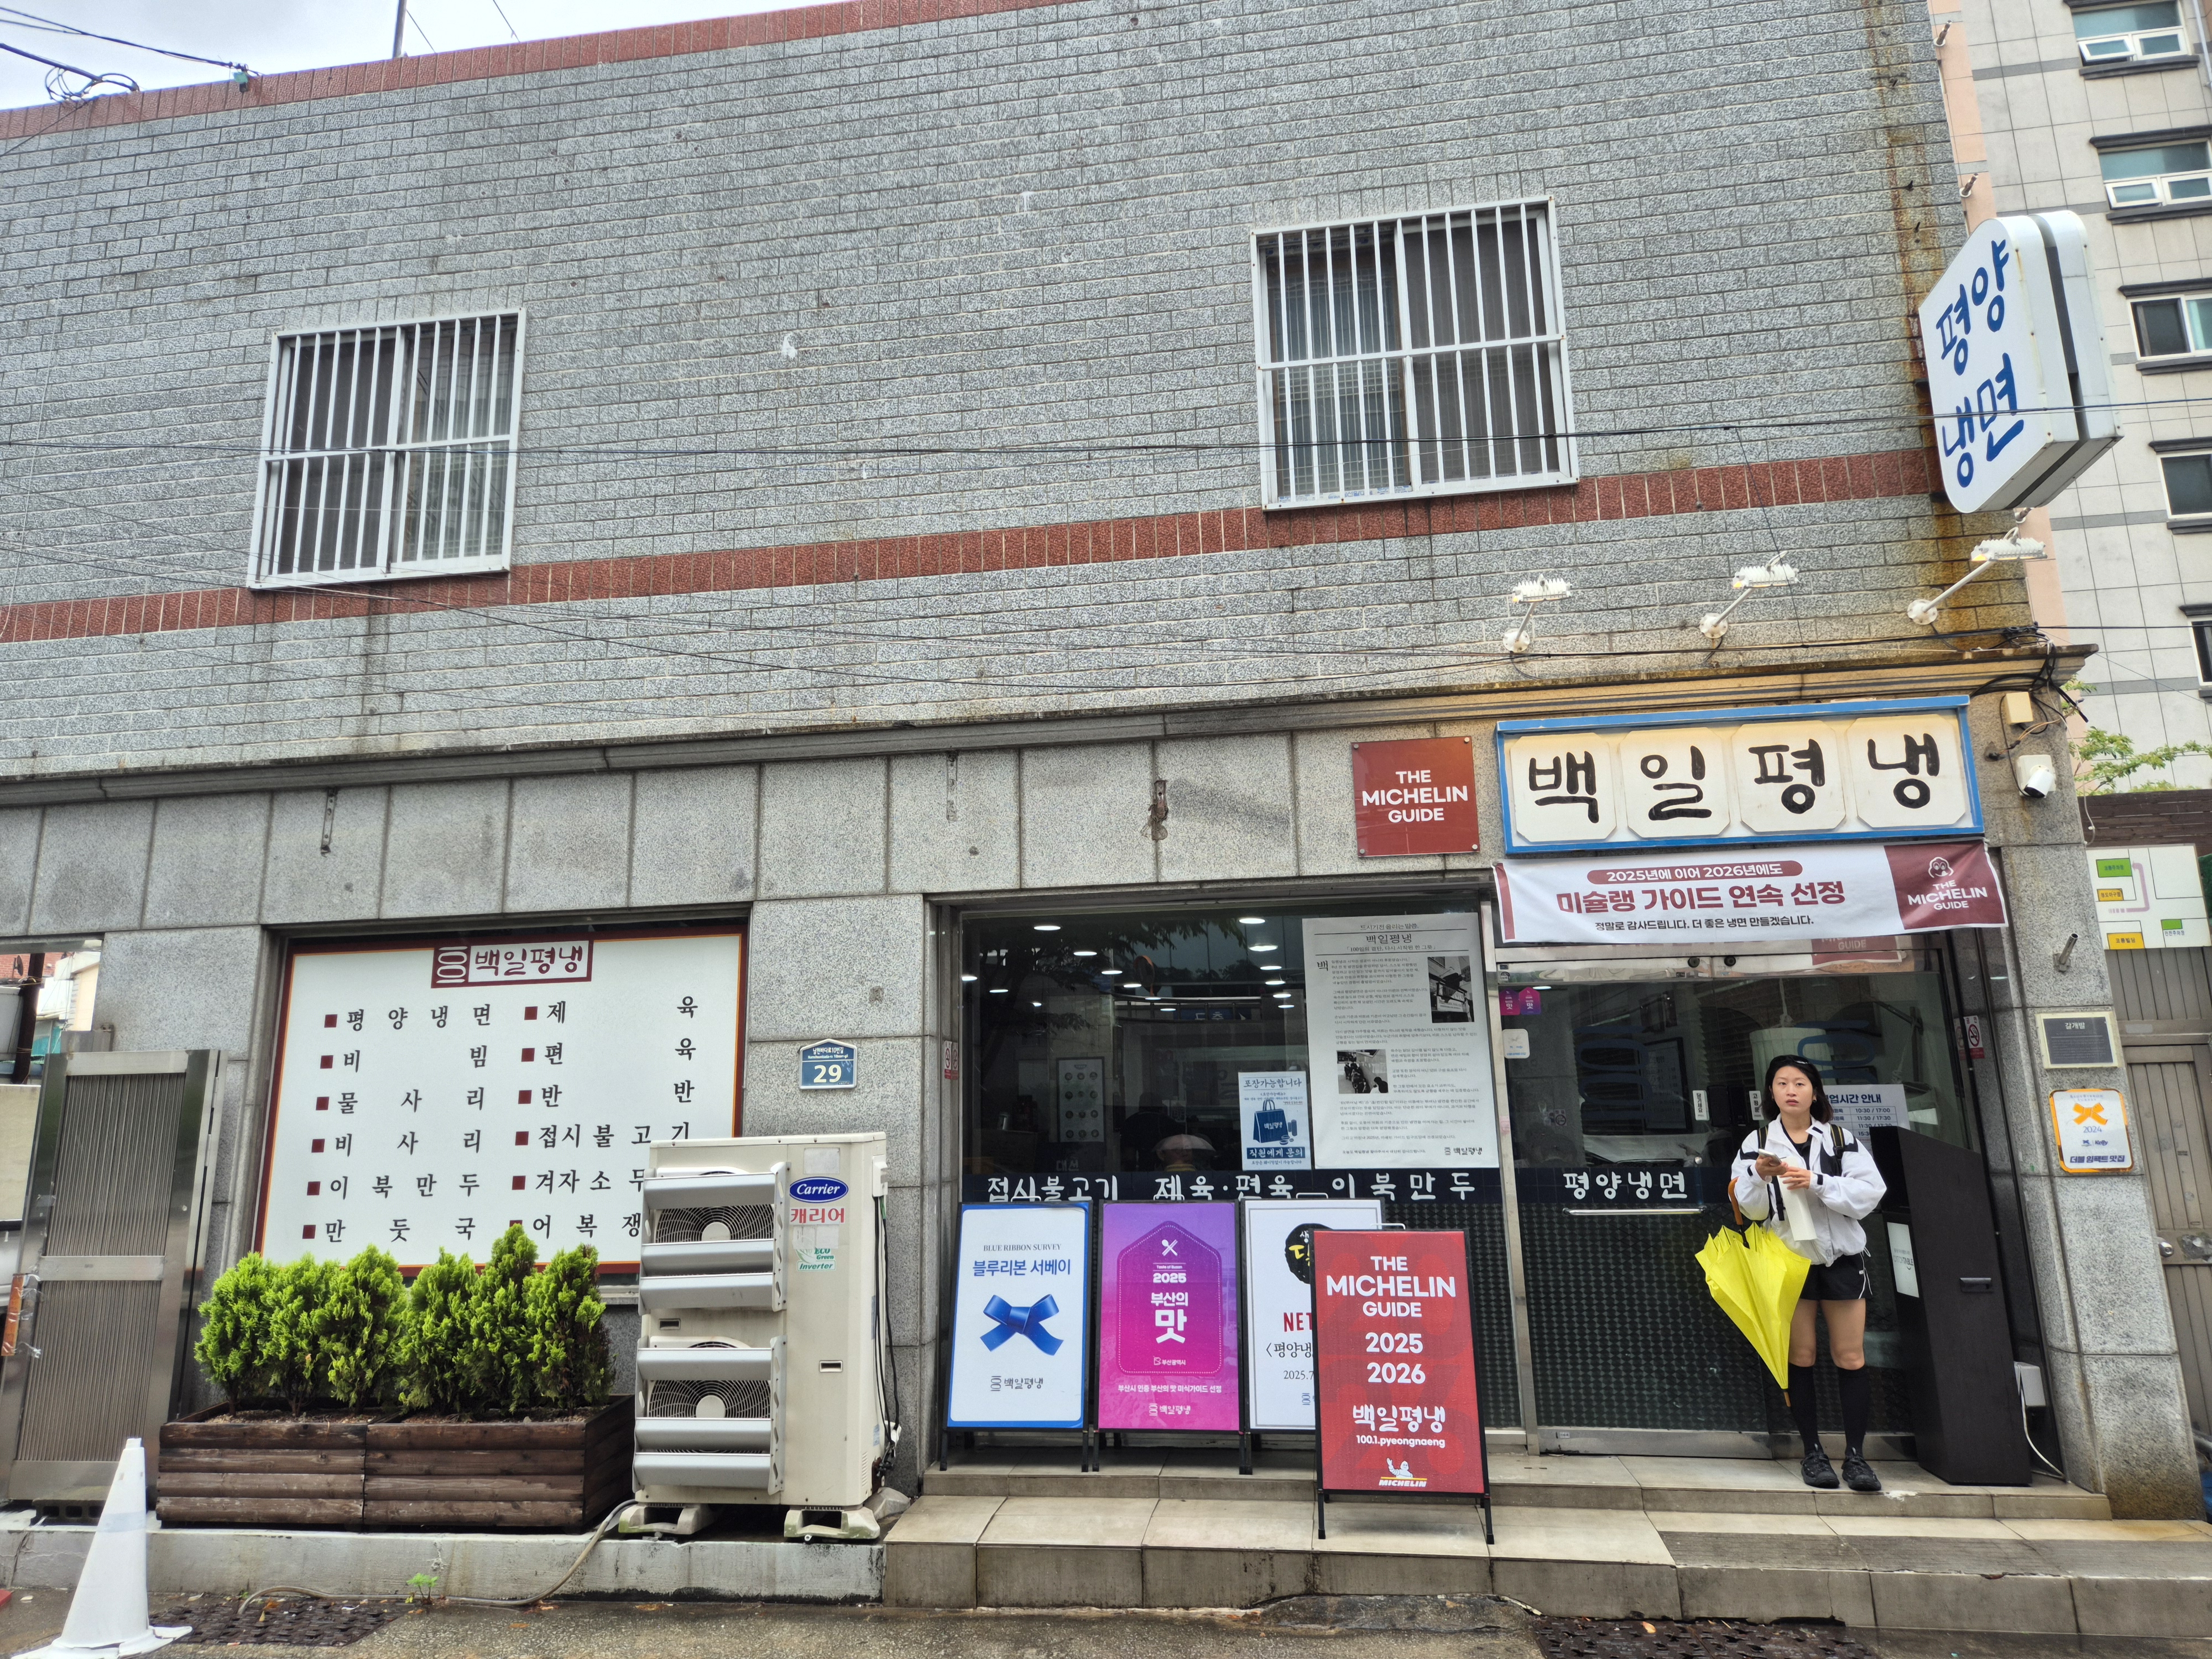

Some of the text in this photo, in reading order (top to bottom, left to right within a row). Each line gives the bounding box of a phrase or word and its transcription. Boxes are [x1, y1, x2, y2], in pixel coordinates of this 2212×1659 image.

[1936, 239, 2010, 376] 평양
[1942, 352, 2025, 488] 냉면
[1396, 770, 1432, 785] THE
[1528, 733, 1940, 823] 백일평냉
[1362, 785, 1468, 807] MICHELIN
[1388, 807, 1444, 823] GUIDE
[1606, 863, 1784, 883] 2025년에 이어 2026년에도
[1932, 880, 1957, 890] THE
[1557, 880, 1846, 914] 미슐랭 가이드 연속 선정
[1907, 887, 1988, 905] MICHELIN
[1933, 900, 1969, 910] GUIDE
[1595, 915, 1814, 931] 정말로 감사드립니다. 더 좋은 냉면 만들겠습니다.
[1366, 933, 1412, 945] 백일평냉
[474, 944, 583, 977] 백일평냉
[1317, 960, 1328, 972] 백
[346, 1003, 492, 1032] 평양냉면
[813, 1064, 842, 1083] 29
[1243, 1078, 1302, 1089] 포장가능합니다
[1827, 1093, 1882, 1104] 업시간 안내
[538, 1121, 689, 1149] 접시불고기
[1249, 1147, 1303, 1158] 직원에게 문의
[1453, 1146, 1483, 1155] 백일평냉
[330, 1173, 480, 1200] 이북만두
[535, 1169, 645, 1194] 겨자소무
[796, 1183, 841, 1195] Carrier
[987, 1175, 1118, 1202] 접시불고기
[1332, 1171, 1475, 1201] 이북만두
[1562, 1170, 1688, 1199] 평양냉면
[790, 1208, 845, 1224] 캐리어
[533, 1212, 641, 1239] 어복쟁
[972, 1259, 1071, 1277] 블루리본 서베이
[1370, 1256, 1408, 1271] THE
[1153, 1272, 1187, 1283] 2025
[1327, 1275, 1456, 1297] MICHELIN
[1151, 1292, 1188, 1307] 부산의
[1363, 1301, 1422, 1317] GUIDE
[1155, 1308, 1187, 1344] 맛
[1365, 1332, 1423, 1353] 2025
[1366, 1362, 1426, 1384] 2026
[1004, 1376, 1044, 1390] 백일평냉
[1118, 1384, 1136, 1392] 부산시
[1137, 1384, 1150, 1392] 인증
[1151, 1384, 1169, 1392] 부산의
[1170, 1384, 1177, 1392] 맛
[1209, 1385, 1222, 1393] 선정
[1159, 1405, 1191, 1415] 백일평냉
[1353, 1403, 1446, 1433] 백일평냉
[1356, 1434, 1446, 1449] 100.1.pyeongnaeng
[1378, 1479, 1427, 1488] MICHELIN
